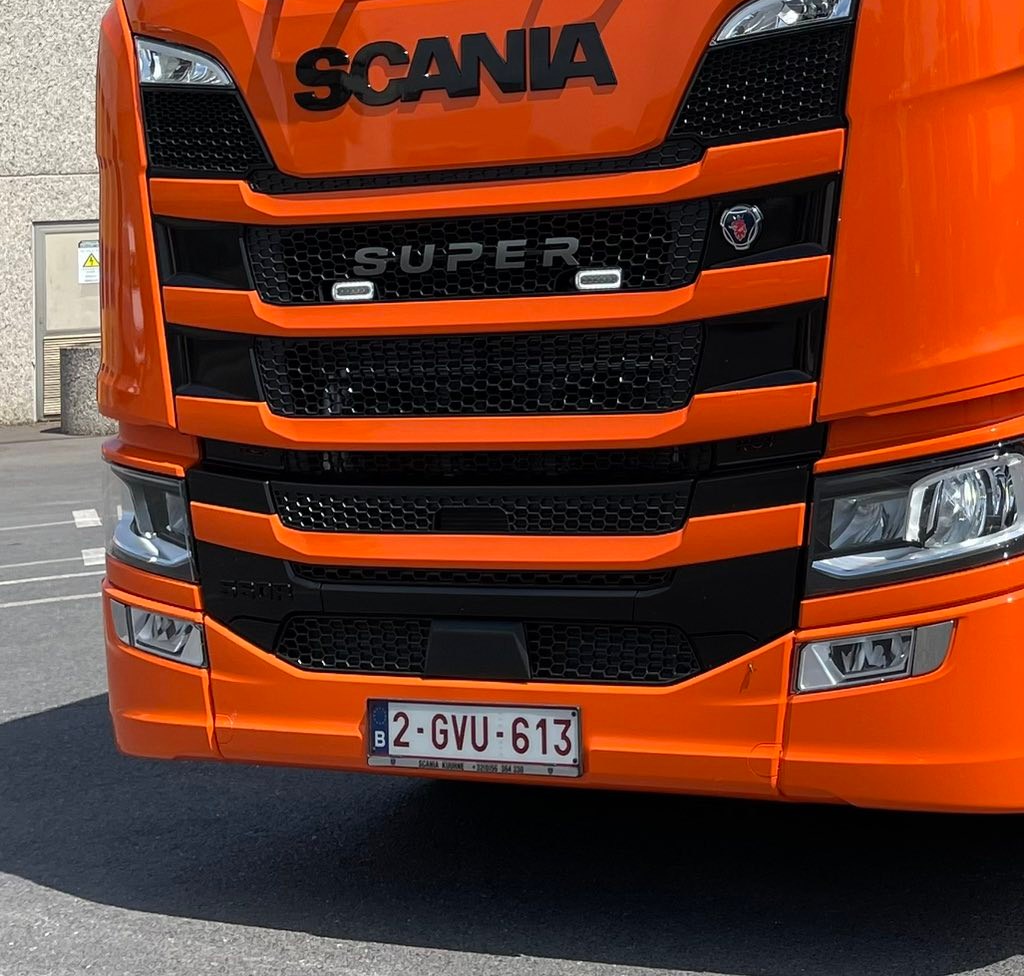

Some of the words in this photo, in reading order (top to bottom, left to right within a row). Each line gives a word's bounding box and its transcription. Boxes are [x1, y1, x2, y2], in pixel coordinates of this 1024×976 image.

[294, 22, 618, 111] SCANIA
[353, 236, 580, 276] SUPER
[374, 730, 386, 747] B
[392, 711, 572, 756] 2-GVU-613
[418, 759, 439, 769] SCANIA
